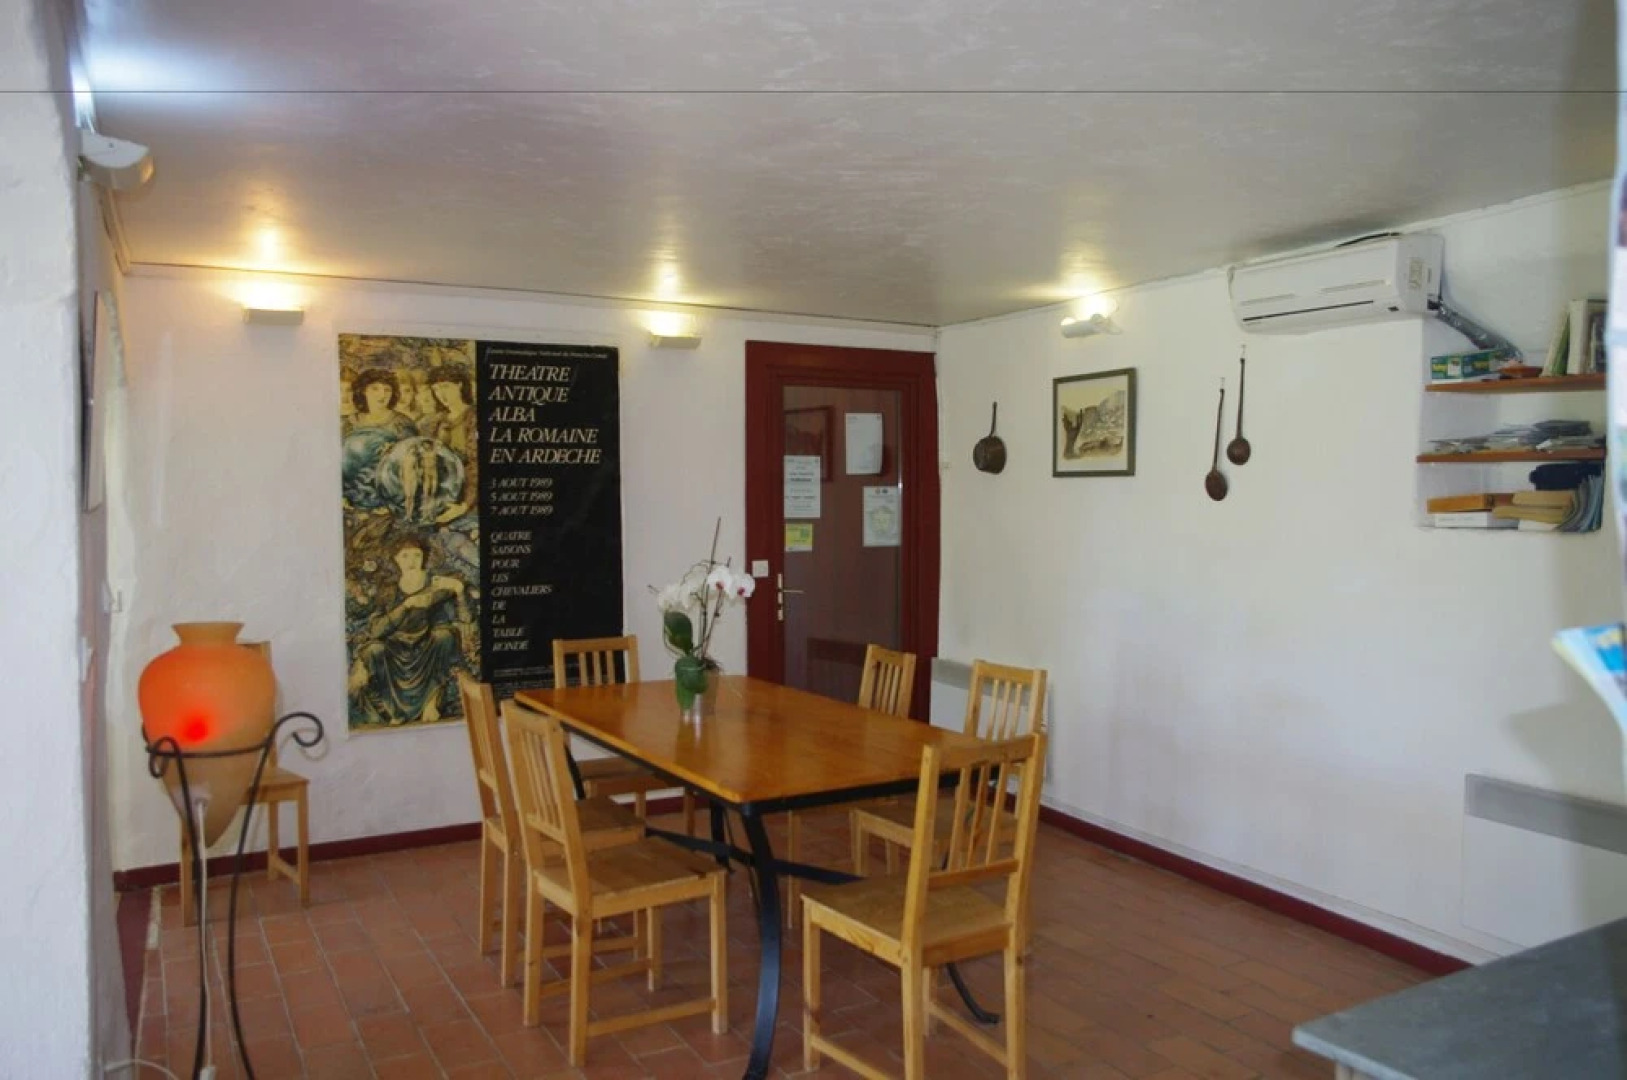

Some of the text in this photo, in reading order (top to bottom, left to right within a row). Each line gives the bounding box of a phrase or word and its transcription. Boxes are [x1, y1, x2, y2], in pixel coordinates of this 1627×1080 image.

[489, 364, 571, 382] THEATRE
[488, 385, 570, 406] ANTIQUE
[488, 406, 535, 422] ALBA
[489, 428, 599, 444] LA ROMAINE
[490, 449, 601, 465] EN ARDECHE
[490, 531, 532, 543] QUATRE
[491, 559, 520, 568] POUR
[491, 573, 509, 583] LES
[491, 585, 553, 597] CHEVALIERS
[492, 600, 506, 610] DE
[492, 614, 506, 624] LA
